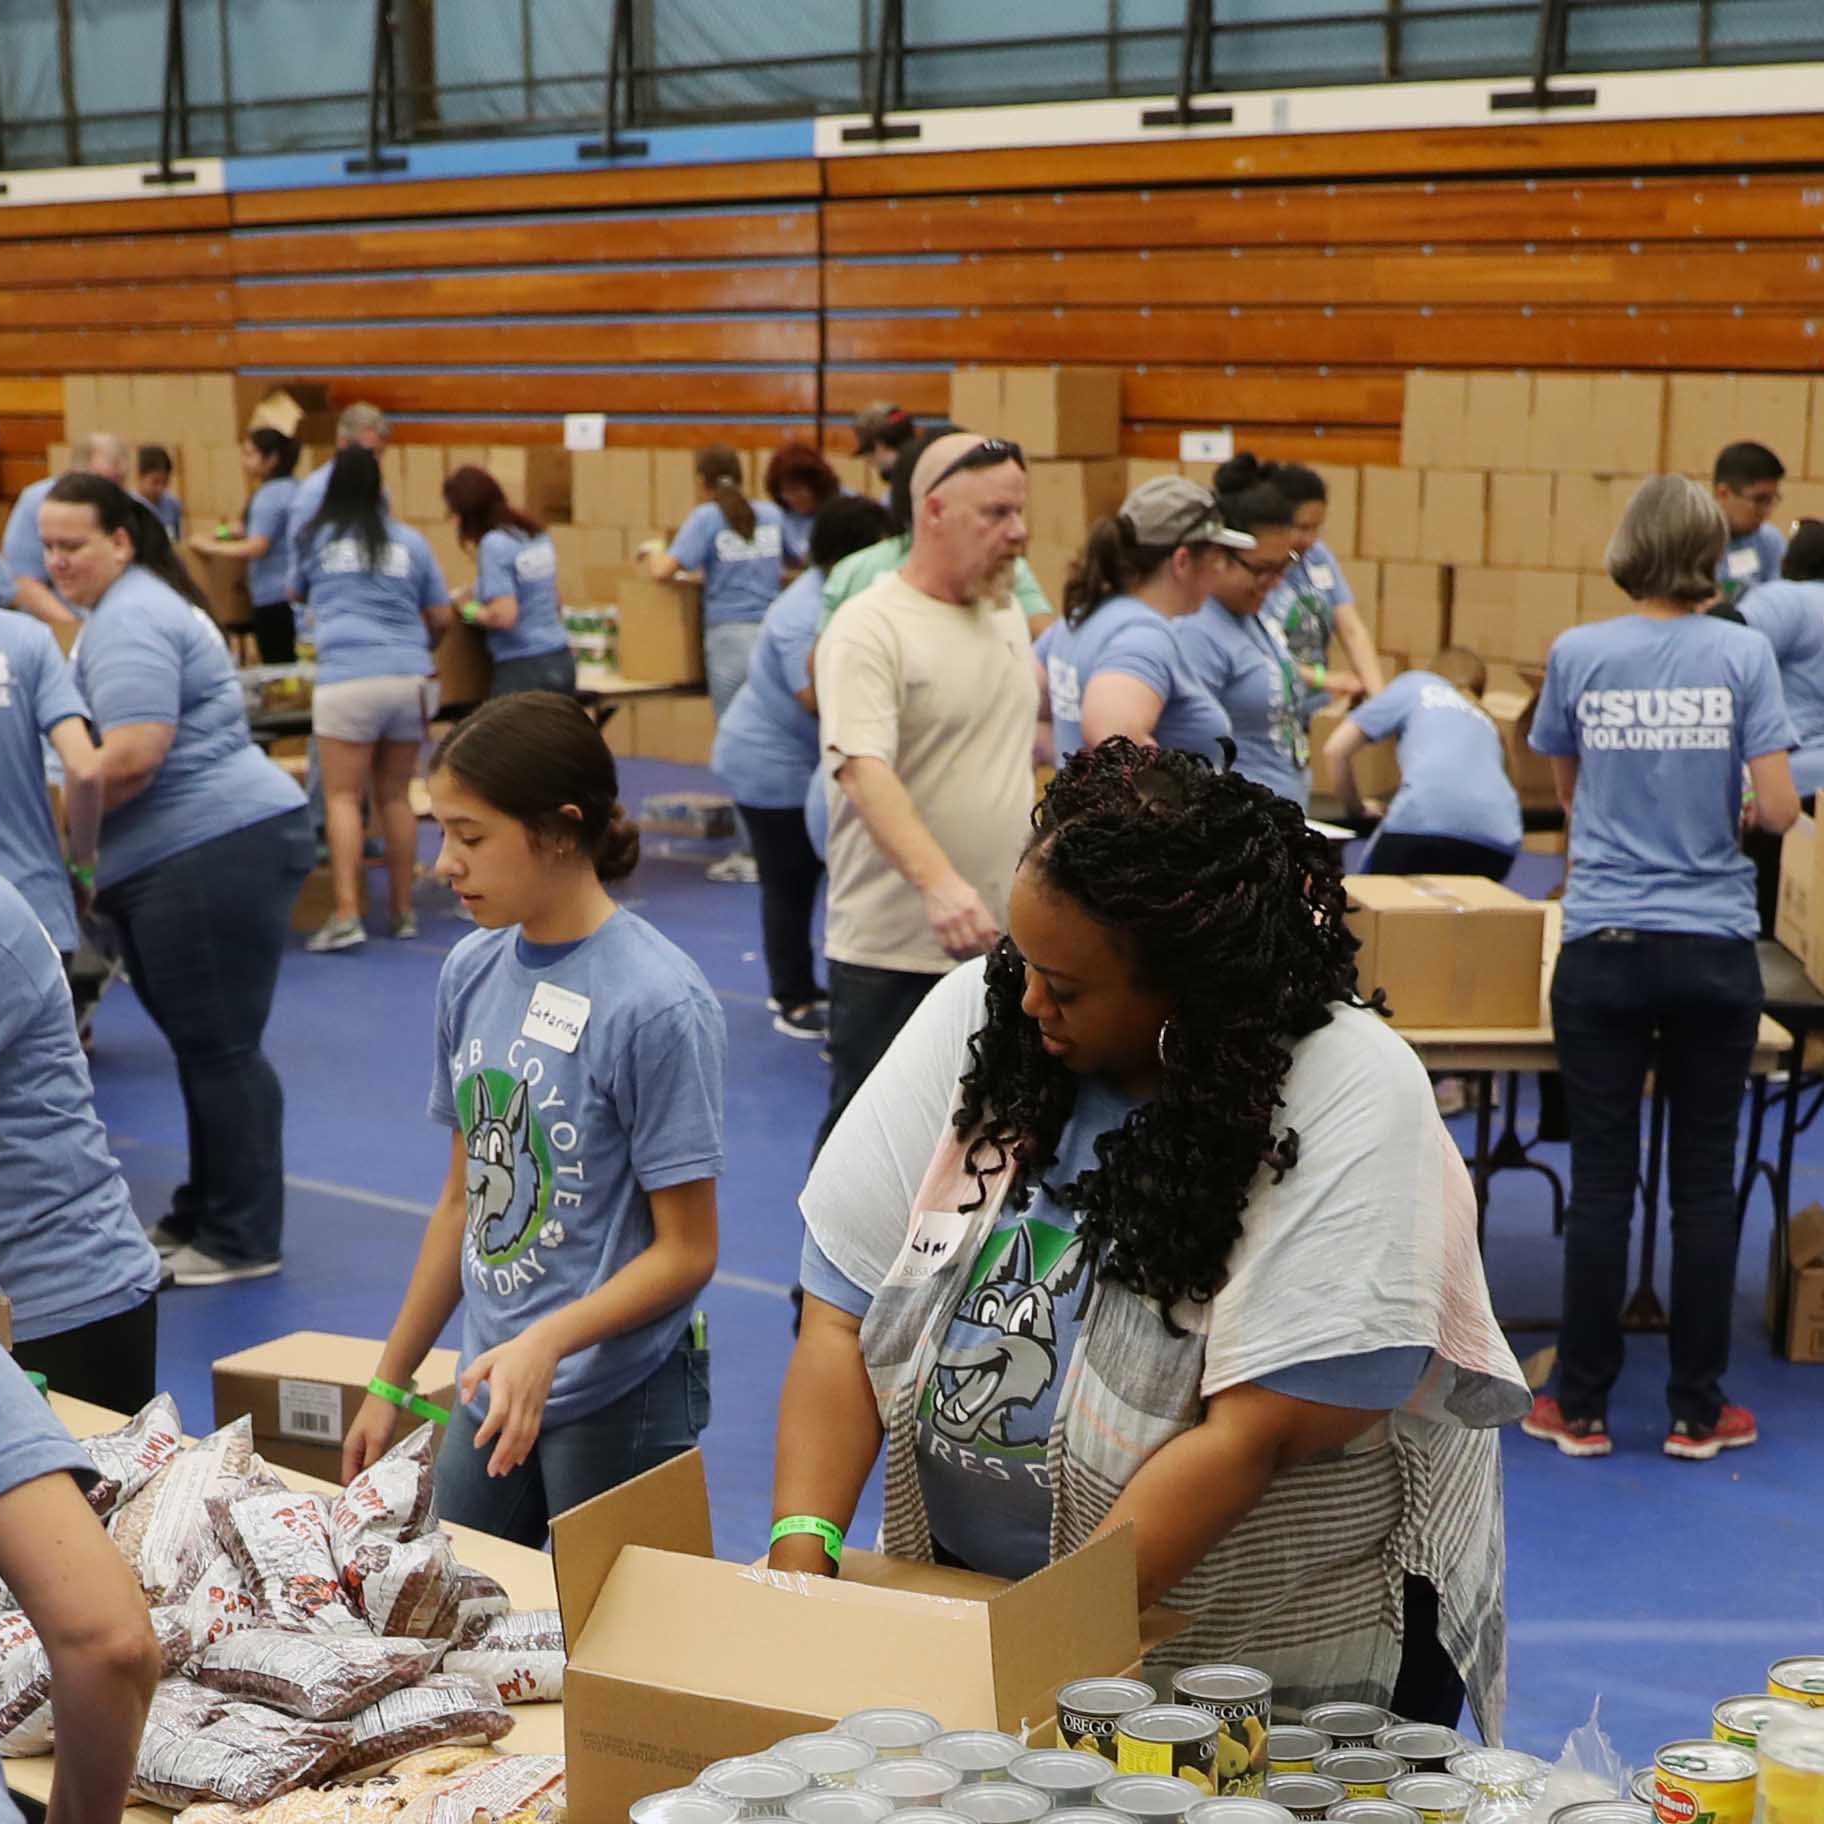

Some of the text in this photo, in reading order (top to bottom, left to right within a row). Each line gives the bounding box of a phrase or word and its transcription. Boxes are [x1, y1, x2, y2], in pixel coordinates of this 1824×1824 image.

[1576, 687, 1733, 728] CSUSB
[1582, 726, 1730, 750] VOLUNTEER
[527, 1000, 580, 1037] Catarina
[507, 1039, 583, 1209] COYOTE
[493, 1248, 546, 1297] DAY
[917, 1418, 1011, 1481] RES
[1063, 1715, 1119, 1733] OREGO
